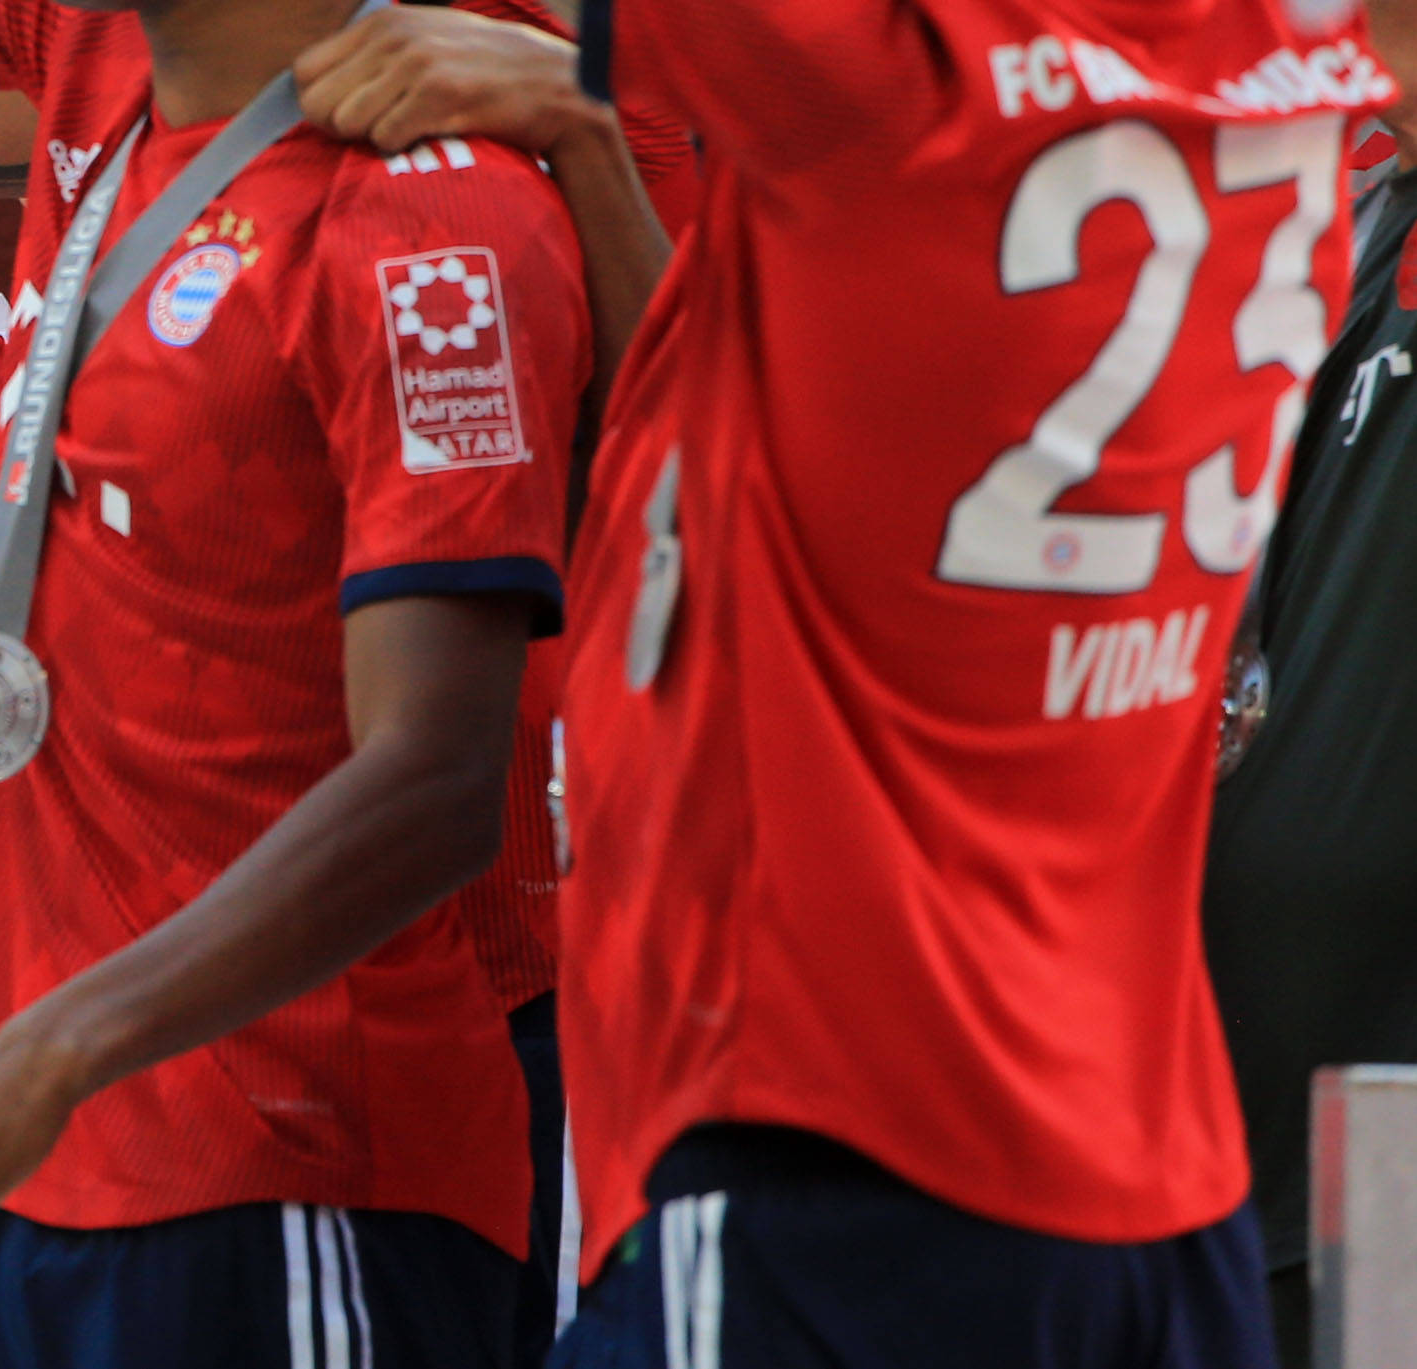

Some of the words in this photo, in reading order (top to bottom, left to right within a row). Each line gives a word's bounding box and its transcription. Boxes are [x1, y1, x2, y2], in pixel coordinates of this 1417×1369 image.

[986, 34, 1076, 118] FC
[401, 360, 508, 396] Hamad
[934, 112, 1347, 595] 23
[406, 392, 509, 426] Airport
[427, 429, 516, 460] ATAR
[1042, 604, 1209, 720] VIDAL
